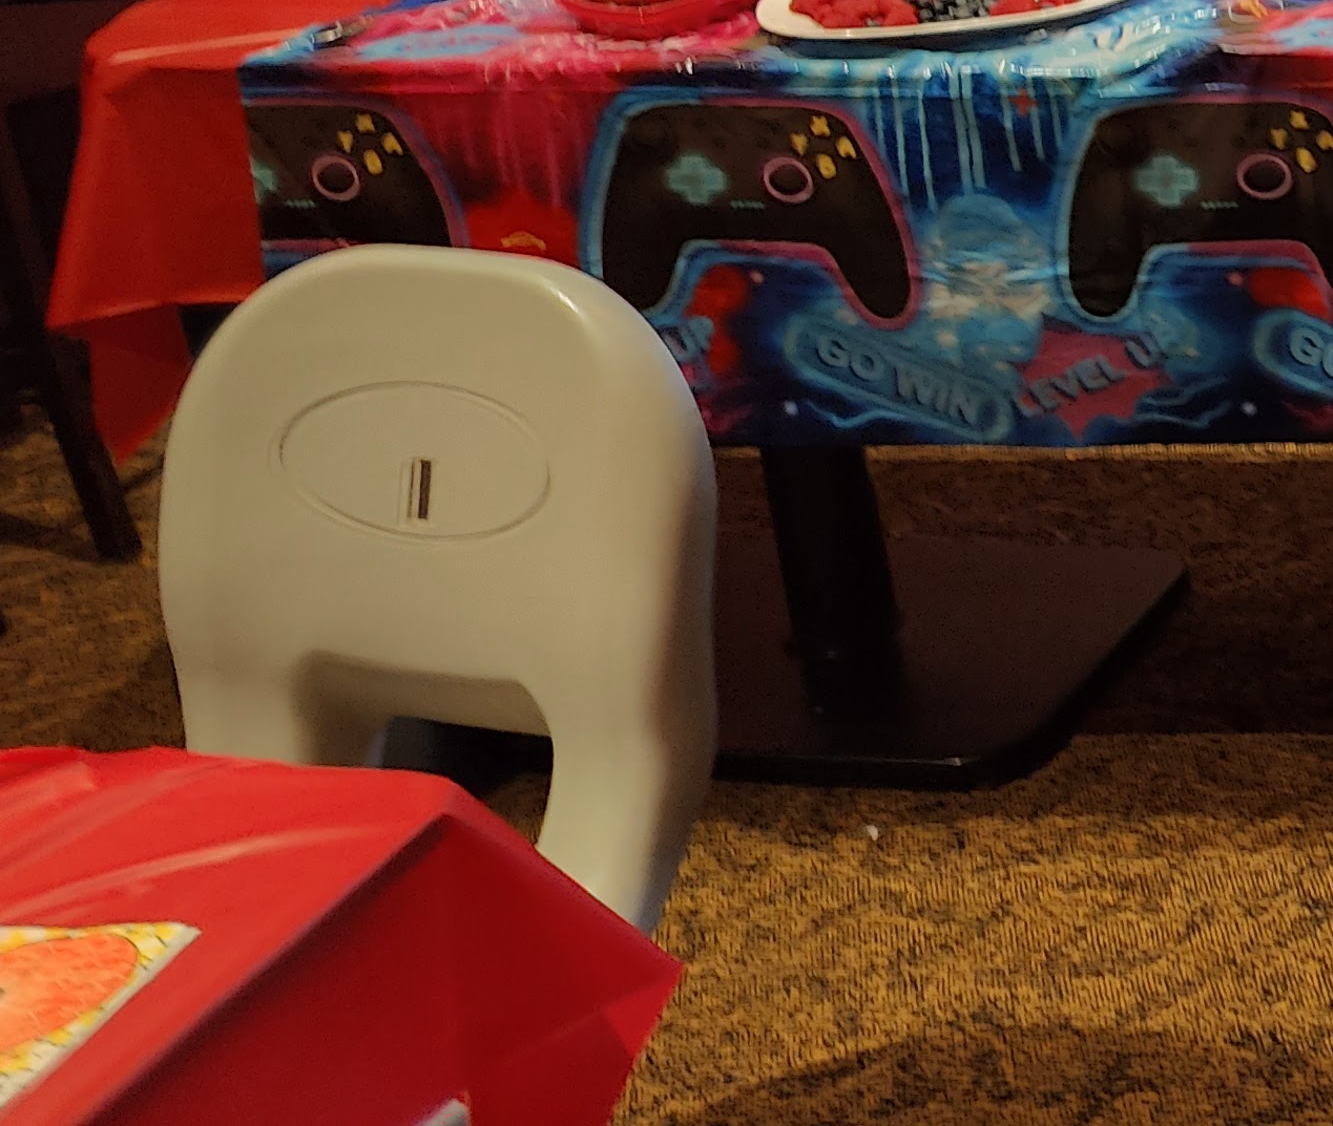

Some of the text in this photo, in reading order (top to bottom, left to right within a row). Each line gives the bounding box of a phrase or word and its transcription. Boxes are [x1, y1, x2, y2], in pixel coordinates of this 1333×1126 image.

[816, 335, 982, 426] GO WIN
[1009, 352, 1130, 418] LEVEL
